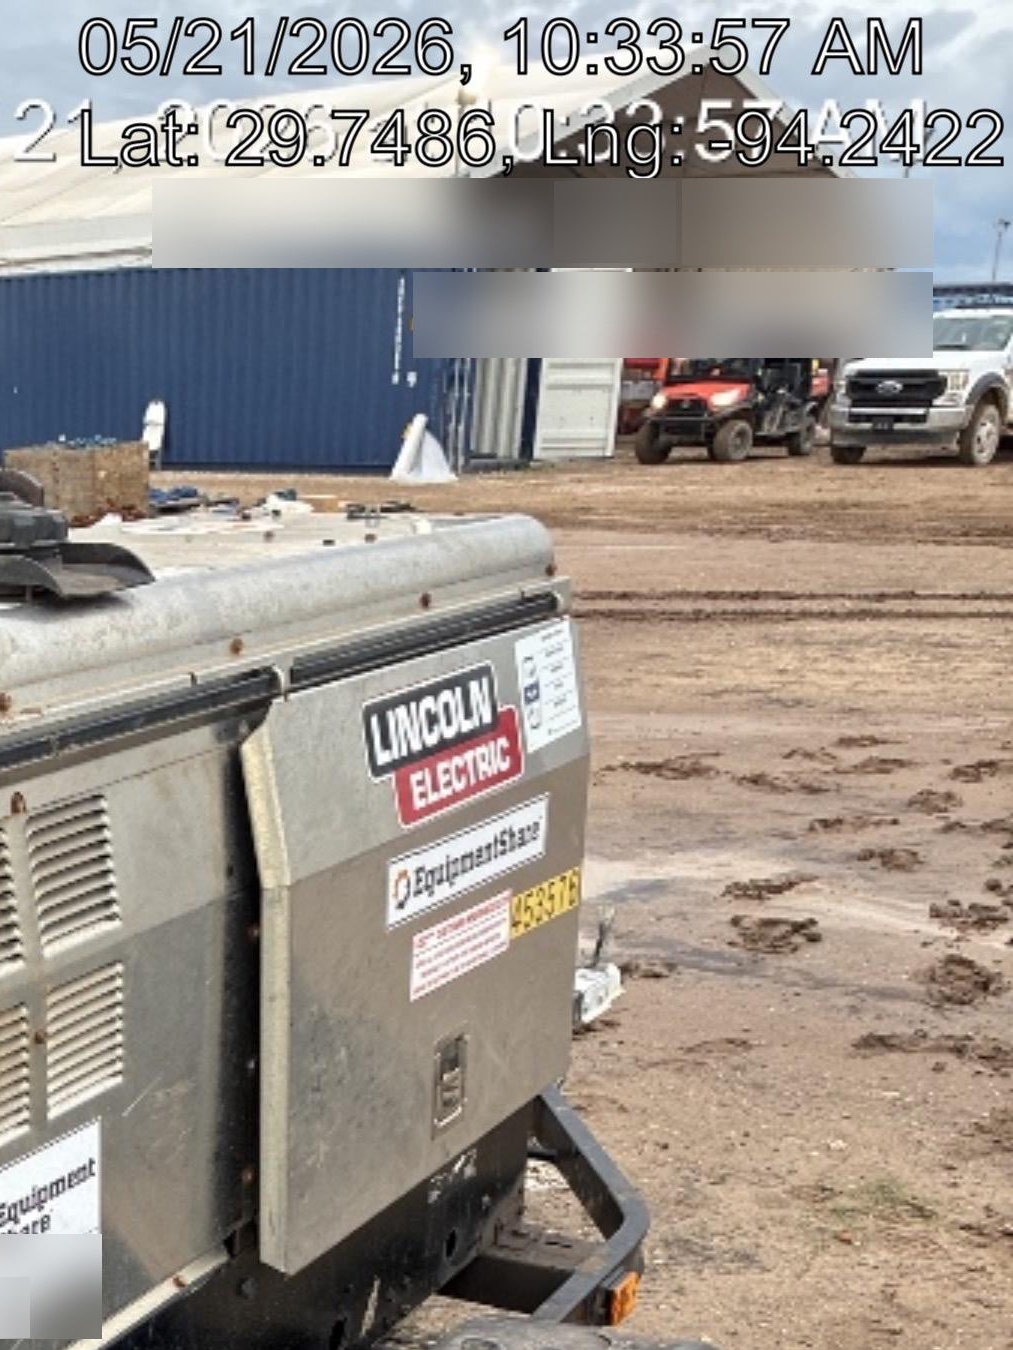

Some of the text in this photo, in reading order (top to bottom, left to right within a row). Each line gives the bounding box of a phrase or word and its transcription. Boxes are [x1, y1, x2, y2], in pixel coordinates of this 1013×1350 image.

[369, 676, 493, 767] LINCOLN
[409, 736, 511, 811] ELECTRIC
[412, 820, 541, 898] EquipmentShare
